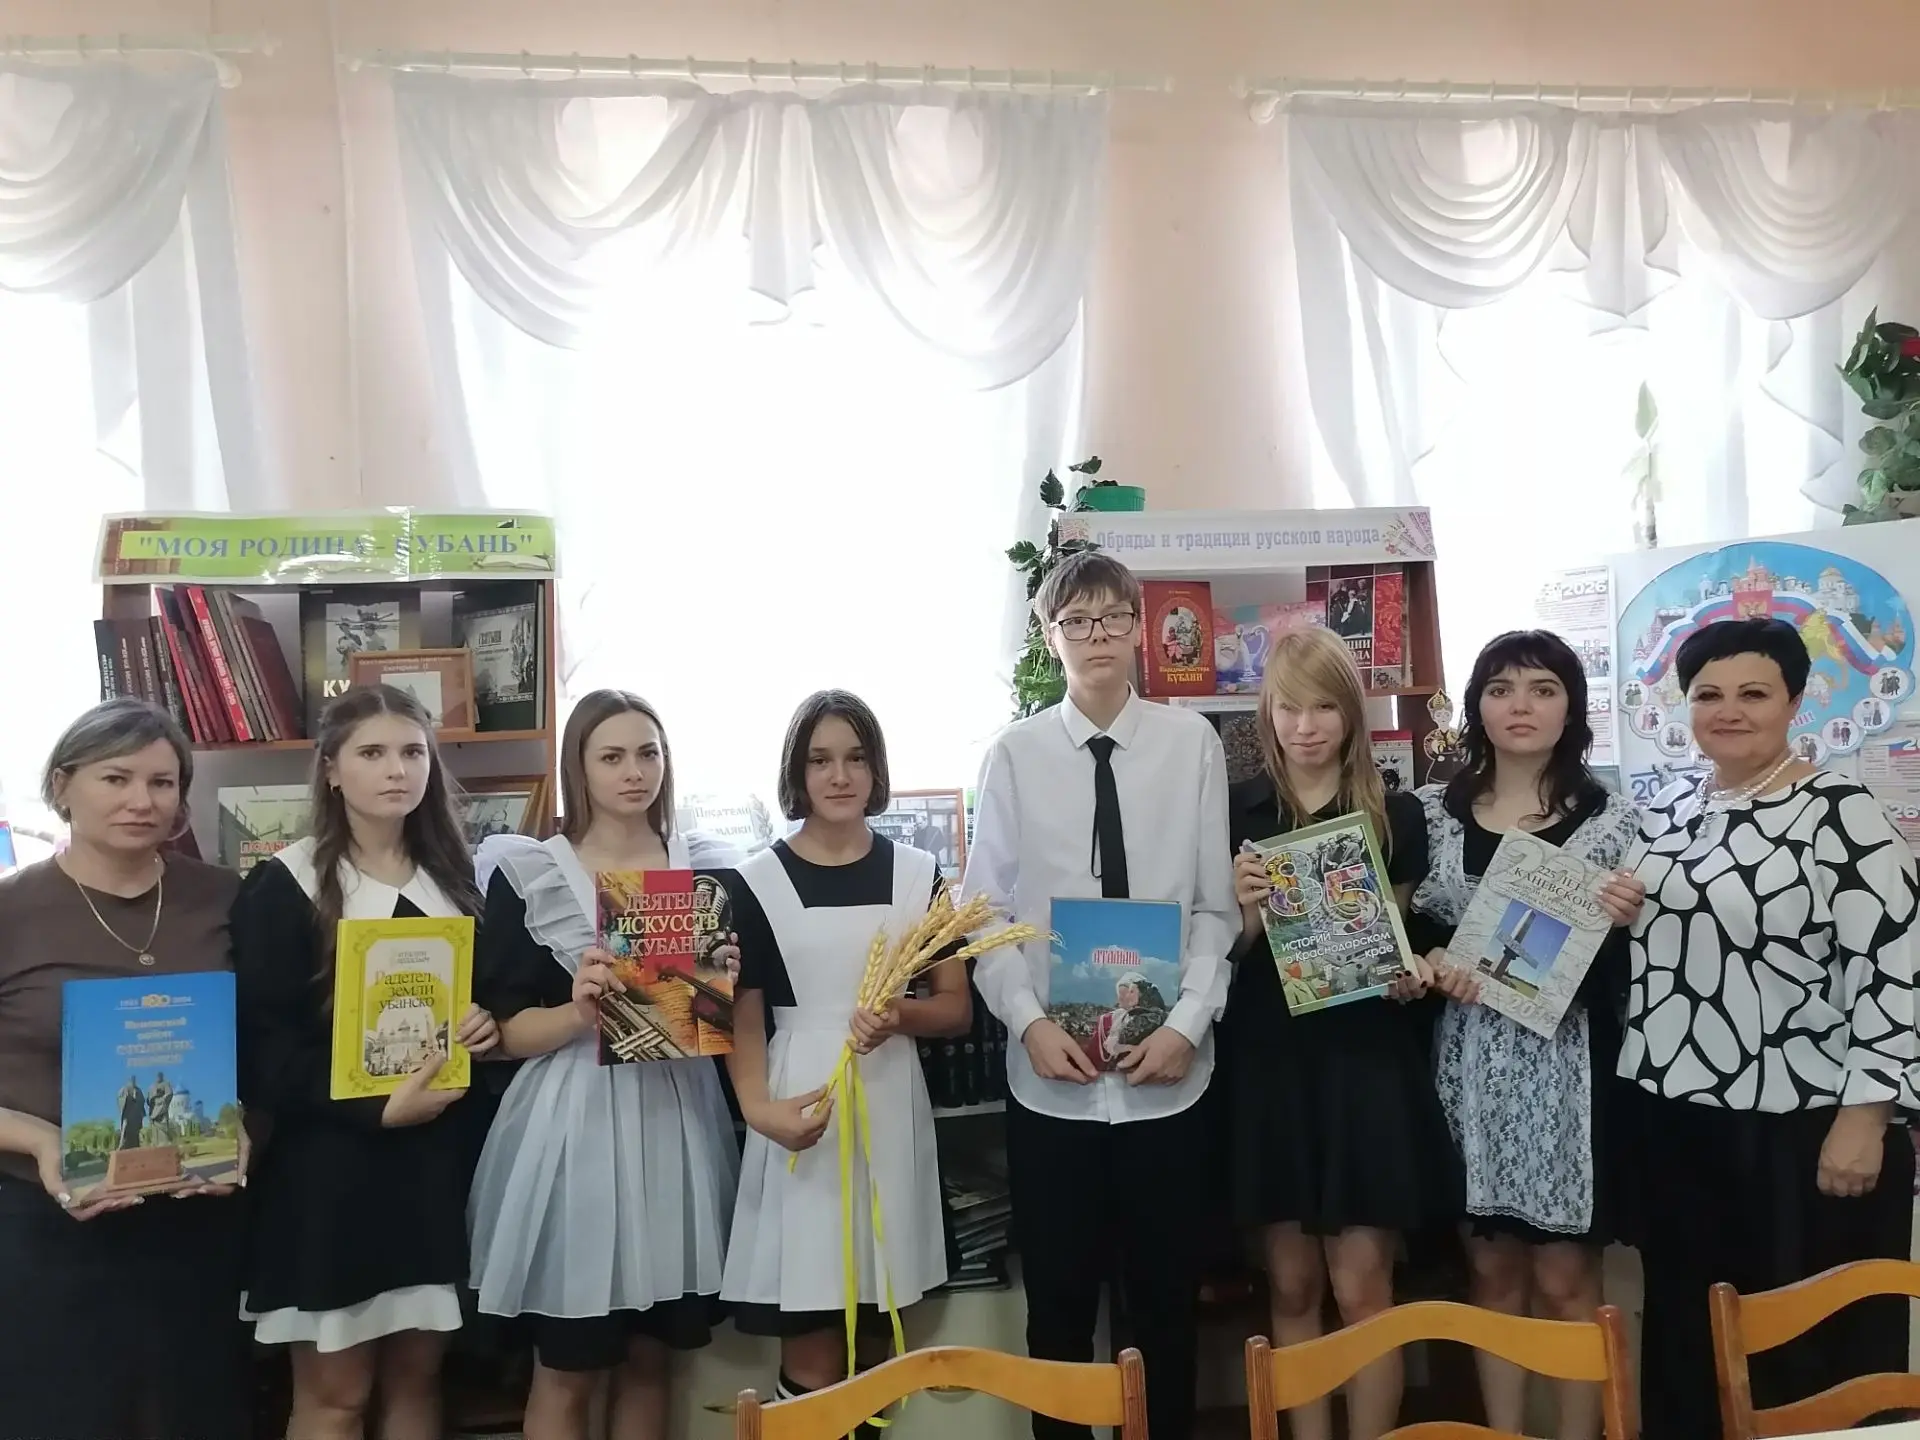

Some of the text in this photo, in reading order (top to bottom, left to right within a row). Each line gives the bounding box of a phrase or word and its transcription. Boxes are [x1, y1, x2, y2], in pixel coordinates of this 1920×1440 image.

[140, 536, 229, 558] "МОЯ
[1161, 534, 1171, 548] и
[1176, 532, 1251, 551] традиции
[1256, 530, 1321, 549] русского
[1326, 528, 1380, 546] народа
[1562, 581, 1608, 597] 2026
[624, 891, 712, 917] ДЕЯТЕЛИ
[616, 913, 719, 935] ИСКУССТВ
[629, 935, 710, 957] КУБАНИ
[1295, 932, 1391, 962] Краснодарском
[1364, 944, 1394, 959] крае
